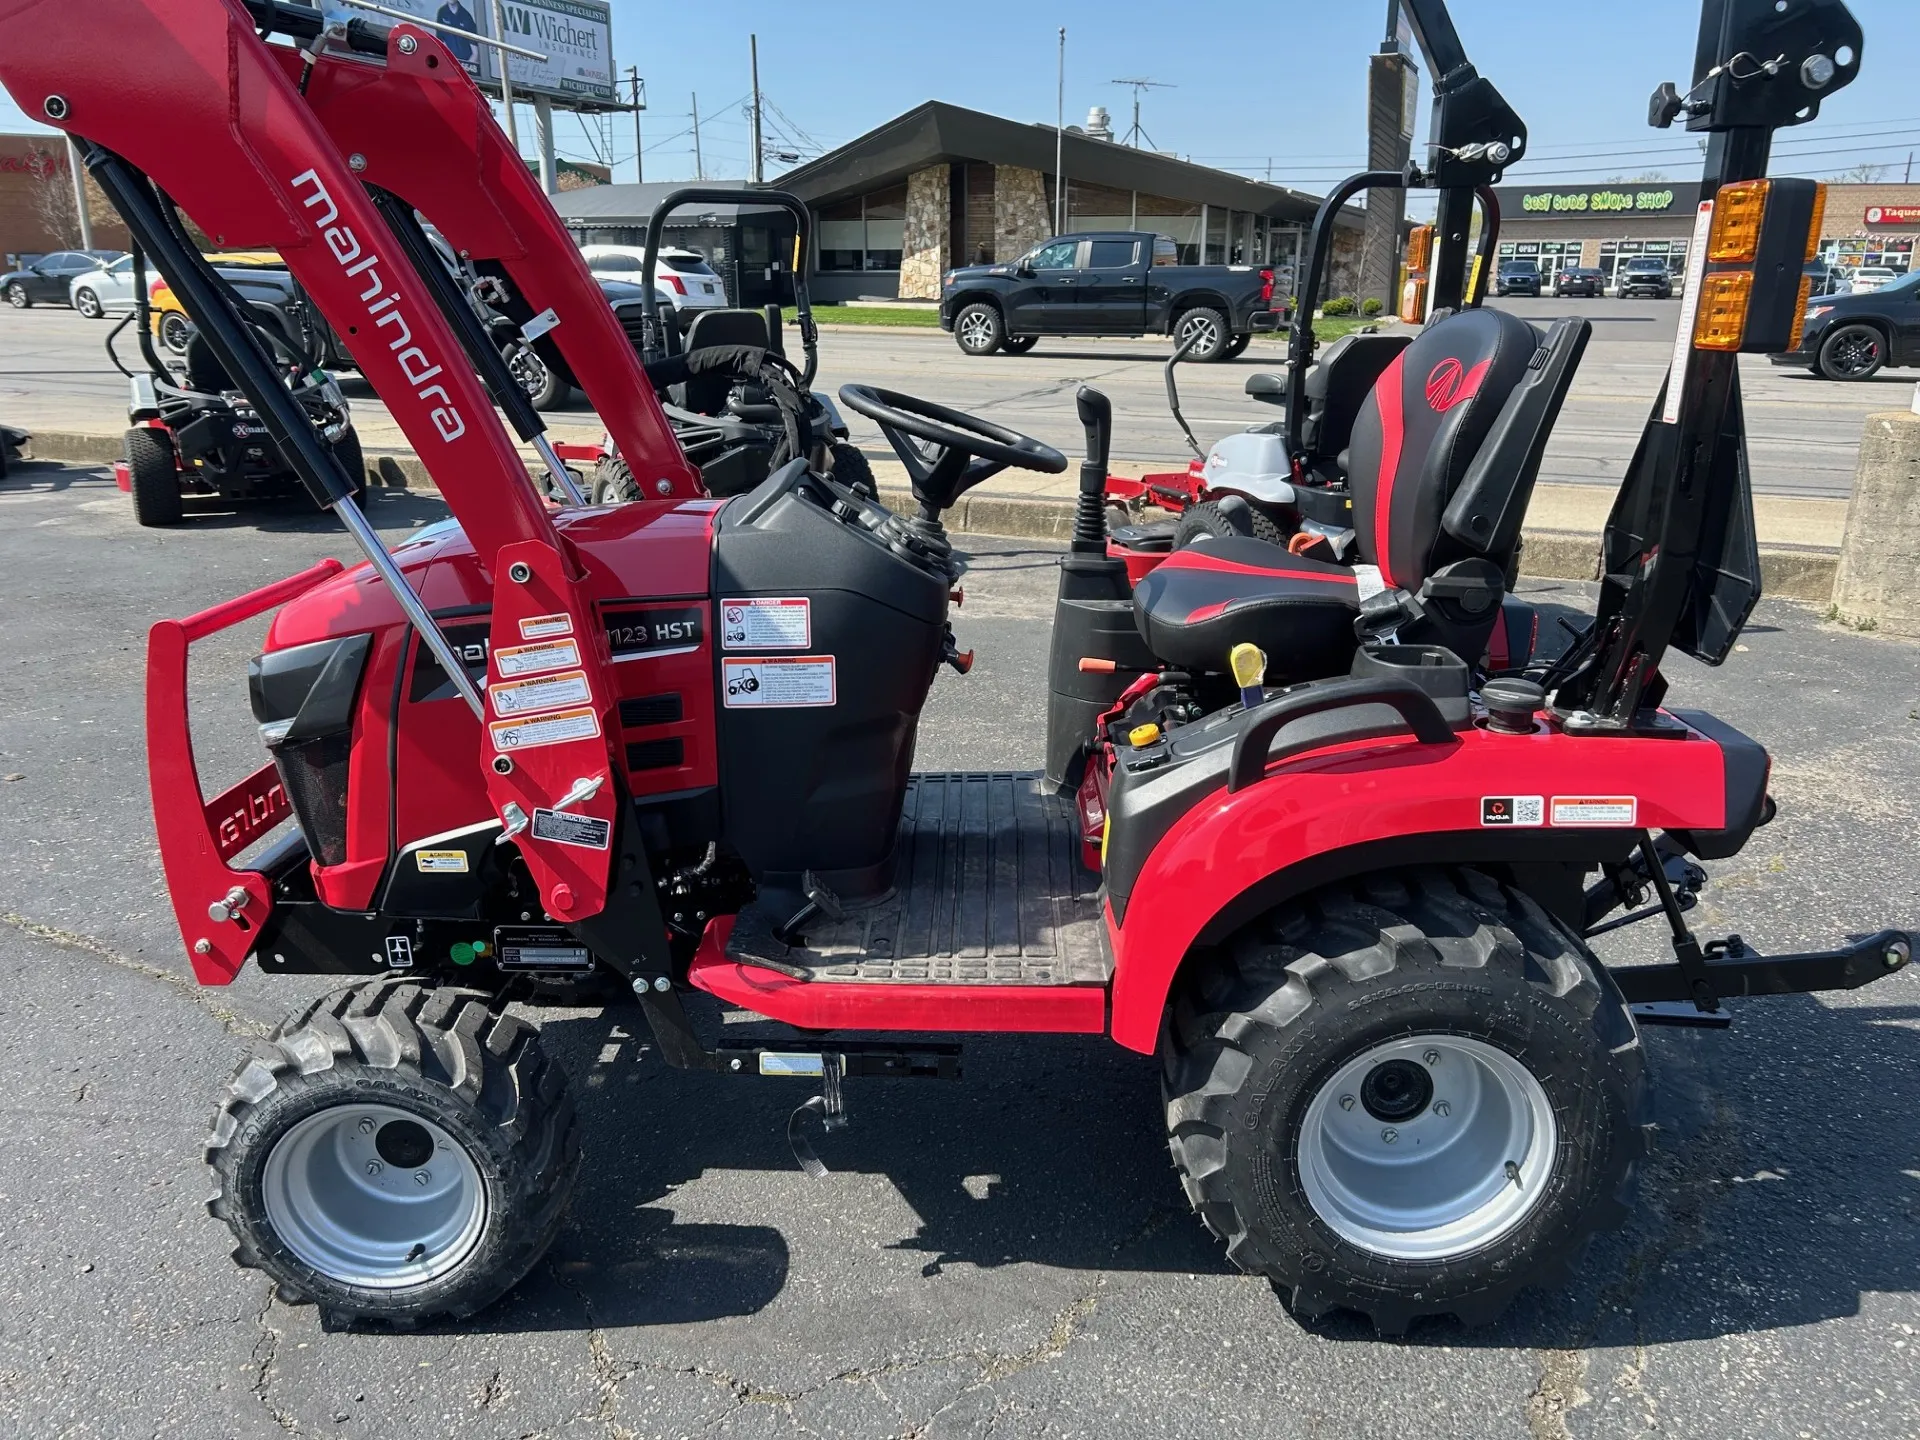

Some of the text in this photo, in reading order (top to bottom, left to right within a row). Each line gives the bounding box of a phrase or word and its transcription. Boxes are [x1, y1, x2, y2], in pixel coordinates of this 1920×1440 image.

[566, 4, 607, 20] SPECIALISTS
[532, 11, 598, 51] Wichert
[540, 40, 598, 60] INSURANCE
[1636, 190, 1673, 209] SHOP
[1518, 245, 1538, 253] OPEN
[291, 168, 465, 443] mahindra
[534, 616, 562, 625] WARNING
[656, 622, 694, 640] HST
[523, 643, 555, 652] WARNING
[525, 676, 557, 686] WARNING
[530, 714, 561, 723] WARNING
[552, 811, 592, 824] INSTRUCTION
[1243, 1021, 1317, 1130] GALAXY
